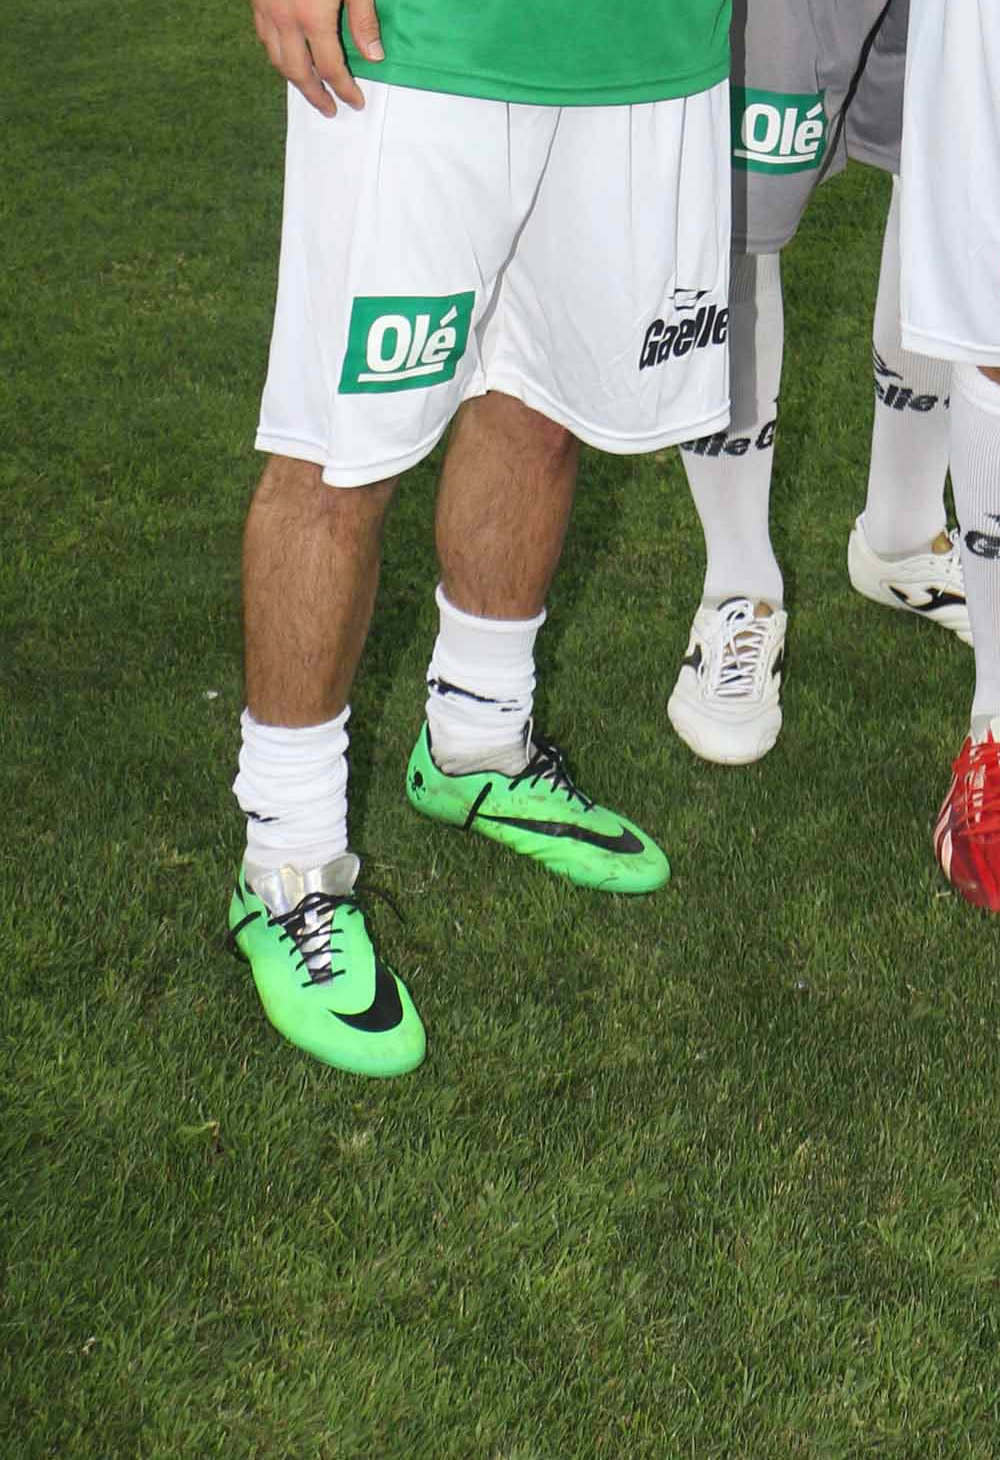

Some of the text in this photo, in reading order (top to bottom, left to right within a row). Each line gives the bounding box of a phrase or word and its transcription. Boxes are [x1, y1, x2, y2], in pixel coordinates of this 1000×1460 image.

[742, 101, 825, 155] Olé
[365, 305, 459, 373] Olé
[638, 304, 729, 371] Gaelle
